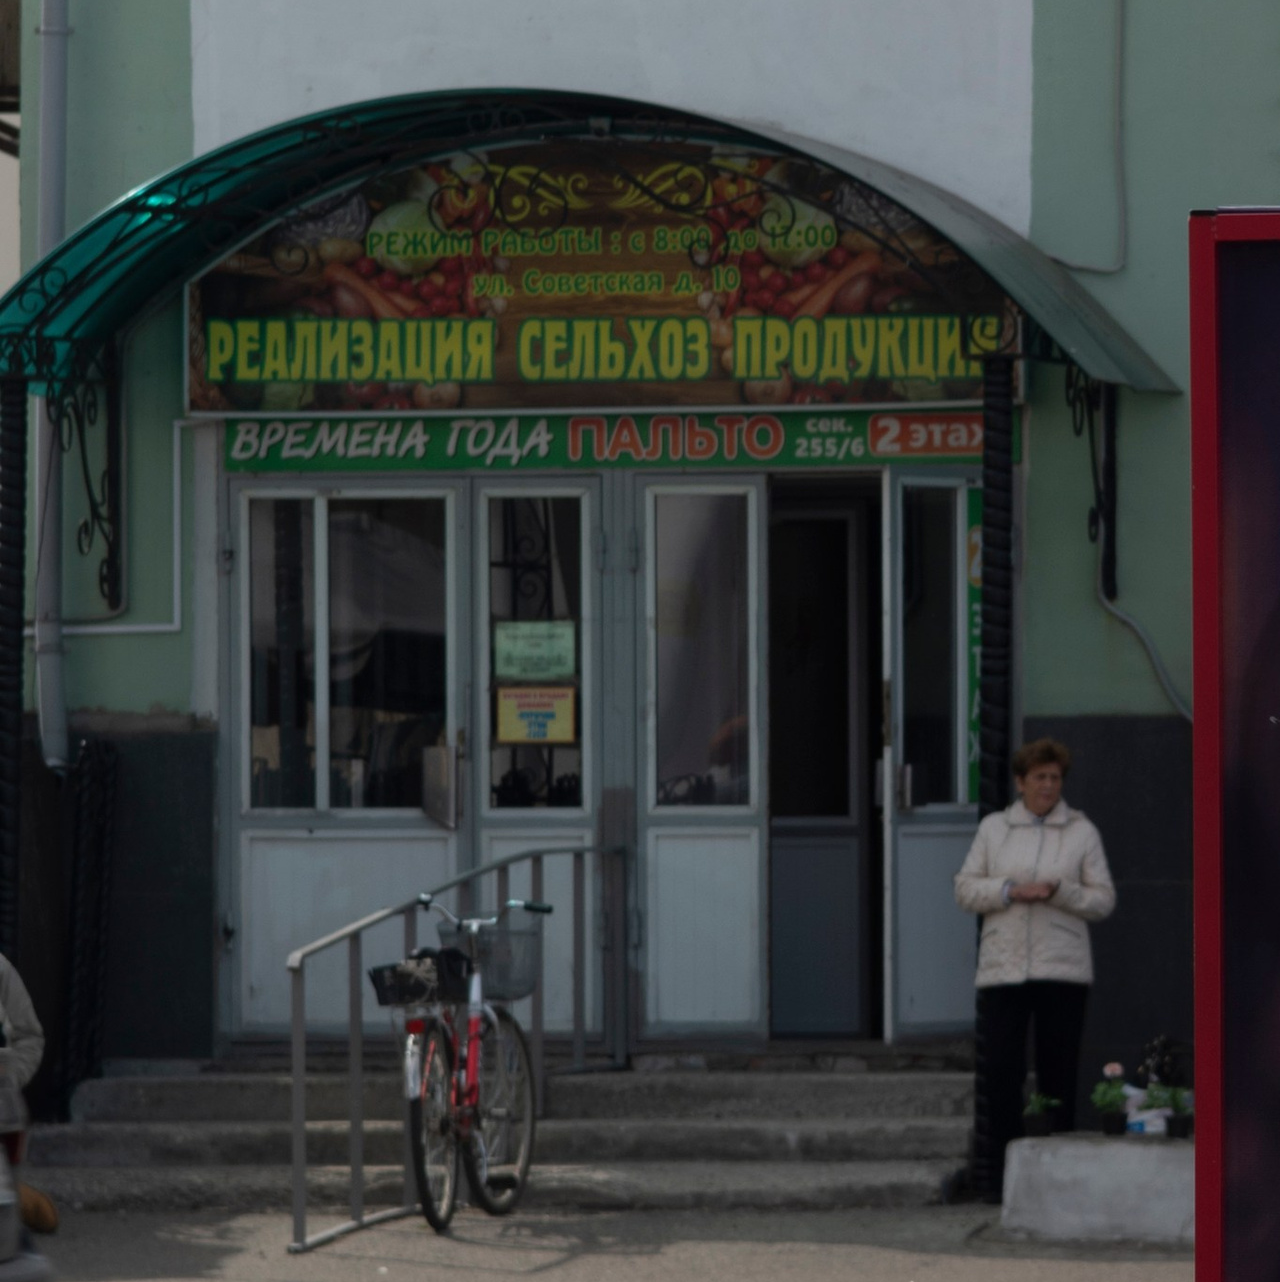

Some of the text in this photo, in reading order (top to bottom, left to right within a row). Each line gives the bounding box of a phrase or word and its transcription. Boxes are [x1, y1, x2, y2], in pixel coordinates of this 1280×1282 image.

[367, 228, 473, 257] РЕЖИМ
[482, 226, 601, 256] РАБОТЫ
[654, 226, 712, 252] 8:00
[474, 266, 741, 297] ул. Советская д. 10
[206, 318, 497, 386] РЕАЛИЗАЦИЯ
[517, 317, 711, 383] СЕЛЬХОЗ
[231, 421, 430, 462] ВРЕМЕНА
[446, 418, 553, 466] ГОДА
[568, 414, 785, 463] ПАЛЬТО
[875, 418, 901, 453] 2
[805, 419, 853, 434] сек.
[795, 437, 865, 459] 255/6
